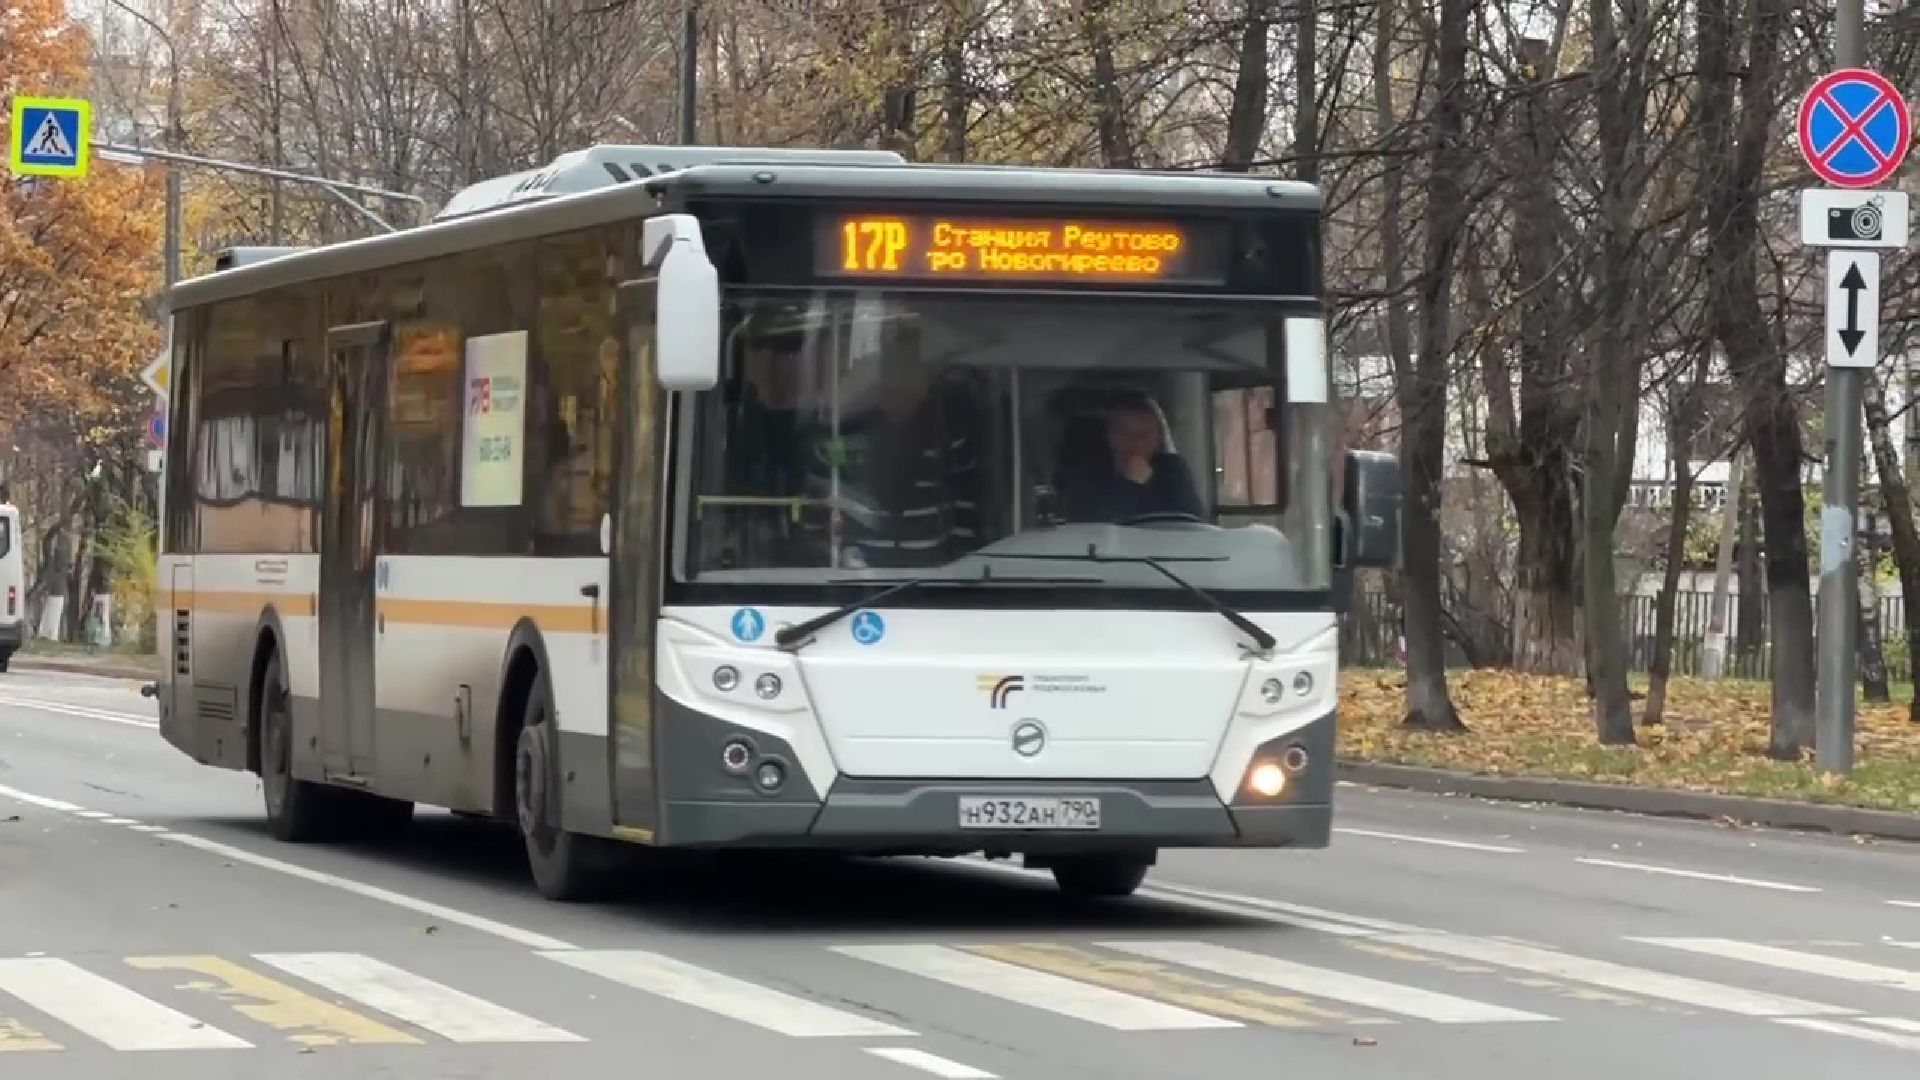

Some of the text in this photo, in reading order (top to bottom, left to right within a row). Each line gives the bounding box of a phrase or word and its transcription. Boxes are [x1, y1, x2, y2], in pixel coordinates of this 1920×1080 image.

[933, 223, 1180, 250] Станция Реутово
[980, 248, 1160, 273] Новогиреево
